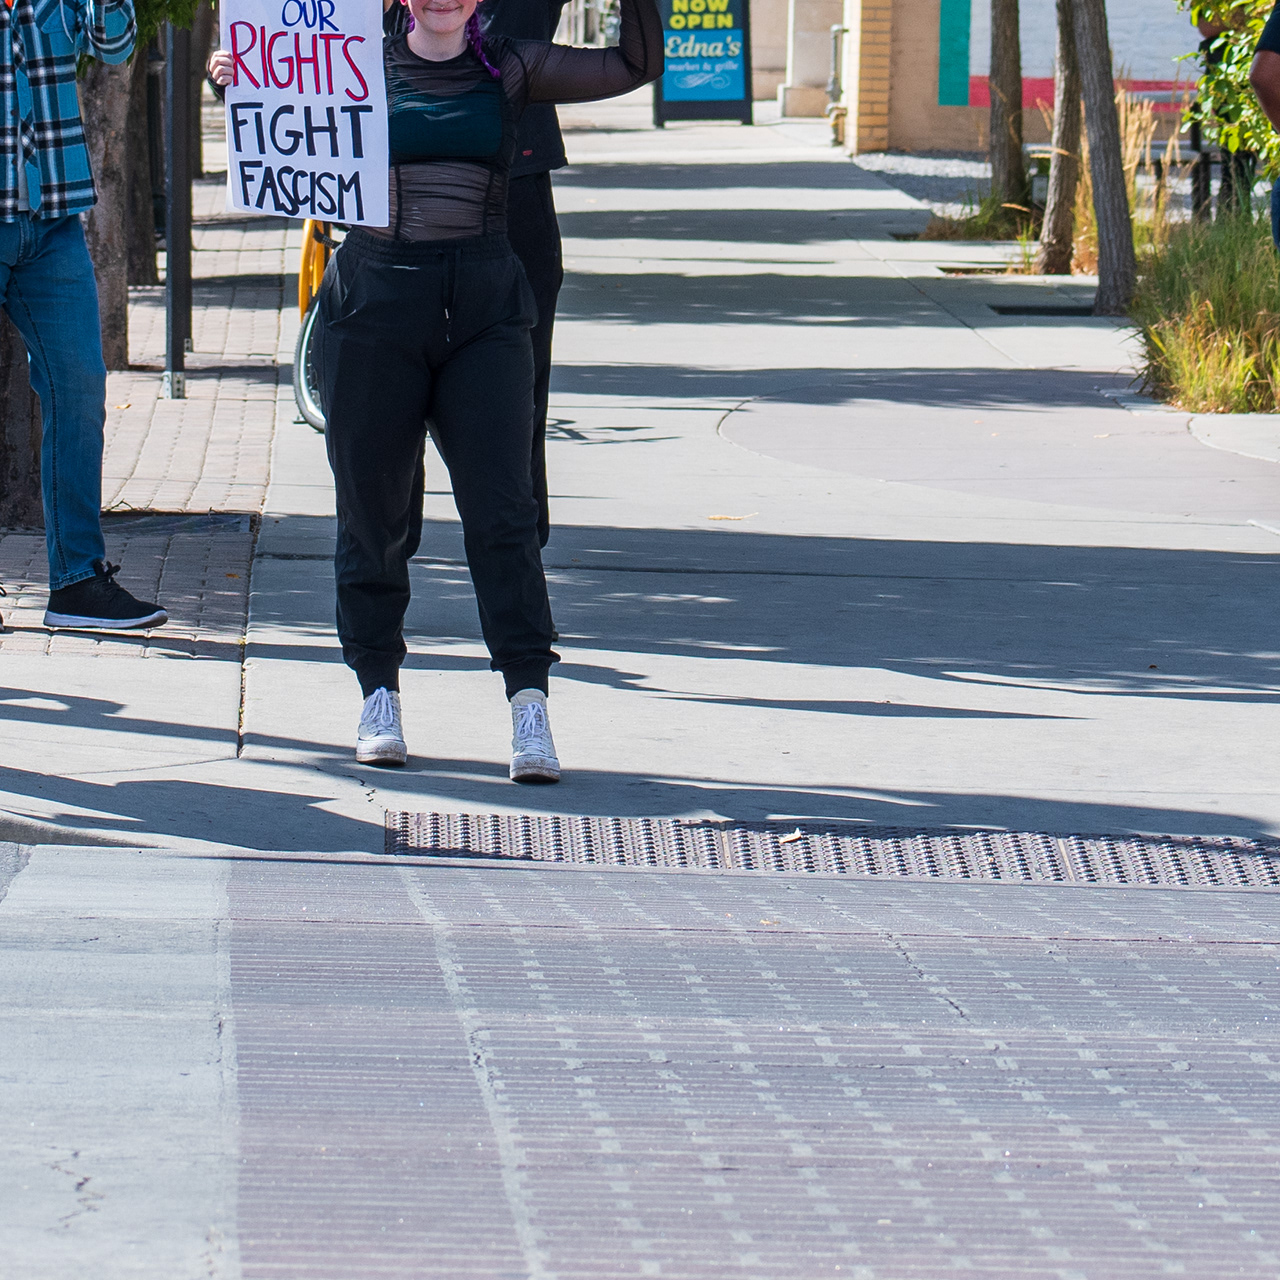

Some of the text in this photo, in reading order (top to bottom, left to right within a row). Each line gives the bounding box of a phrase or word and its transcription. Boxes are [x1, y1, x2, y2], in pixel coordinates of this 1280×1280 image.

[665, 34, 741, 58] Edna's
[669, 13, 733, 29] OPEN
[230, 21, 369, 101] RIGHTS
[230, 102, 373, 158] FIGHT
[239, 160, 365, 221] FASCISM
